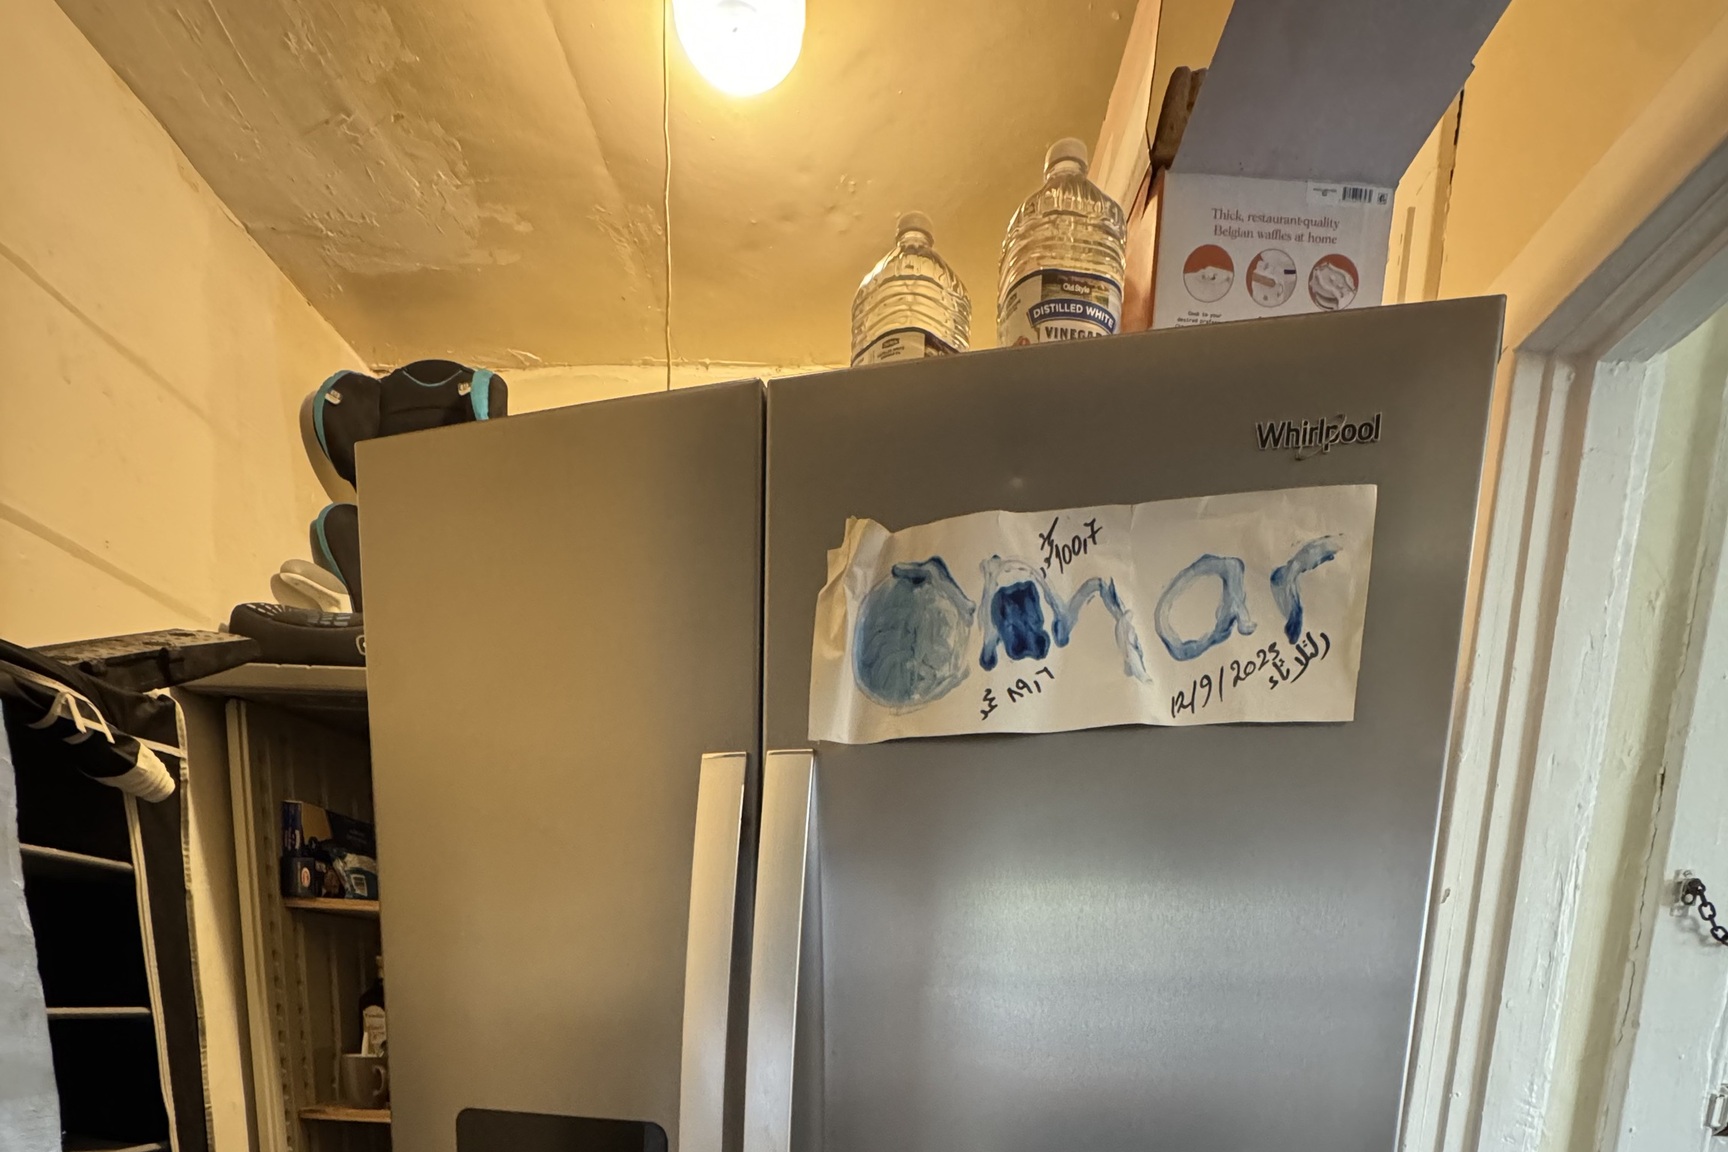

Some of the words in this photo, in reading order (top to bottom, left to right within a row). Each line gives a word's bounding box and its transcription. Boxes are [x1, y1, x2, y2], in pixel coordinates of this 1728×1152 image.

[1211, 208, 1244, 223] Thick,
[1247, 213, 1340, 231] restaurant-quality
[1214, 224, 1254, 240] Belgian
[1257, 228, 1292, 241] waffles
[1294, 232, 1305, 242] at
[1308, 231, 1338, 245] home
[1062, 282, 1075, 291] Old
[1075, 284, 1091, 295] Style
[1033, 303, 1083, 319] DISTILLED
[1085, 305, 1114, 329] WHITE
[1256, 411, 1383, 454] Whirlpool
